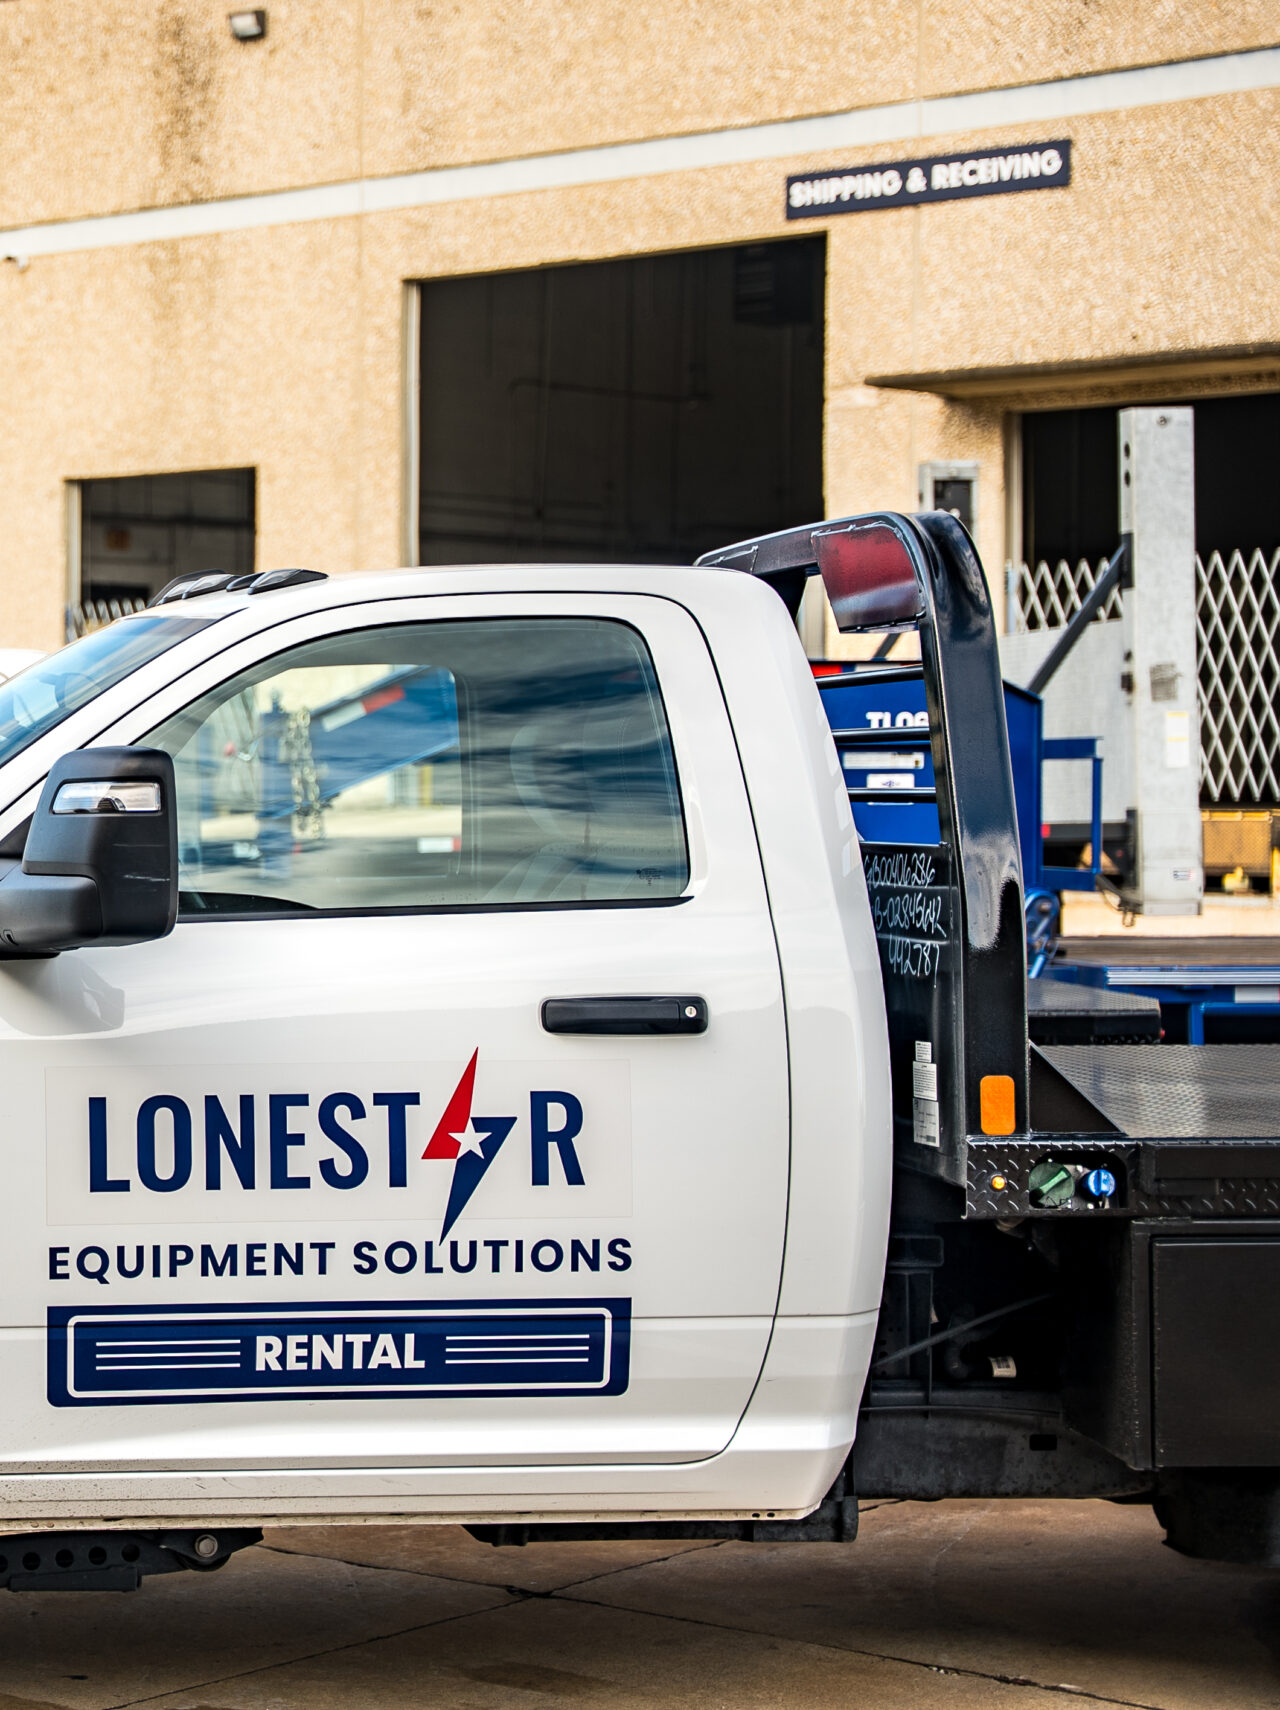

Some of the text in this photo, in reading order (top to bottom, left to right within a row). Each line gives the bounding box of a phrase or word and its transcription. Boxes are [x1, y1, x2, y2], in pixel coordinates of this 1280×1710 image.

[789, 149, 1063, 208] SHIPPING & RECEIVING
[48, 1236, 633, 1285] EQUIPMENT SOLUTIONS
[254, 1332, 426, 1372] RENTAL
